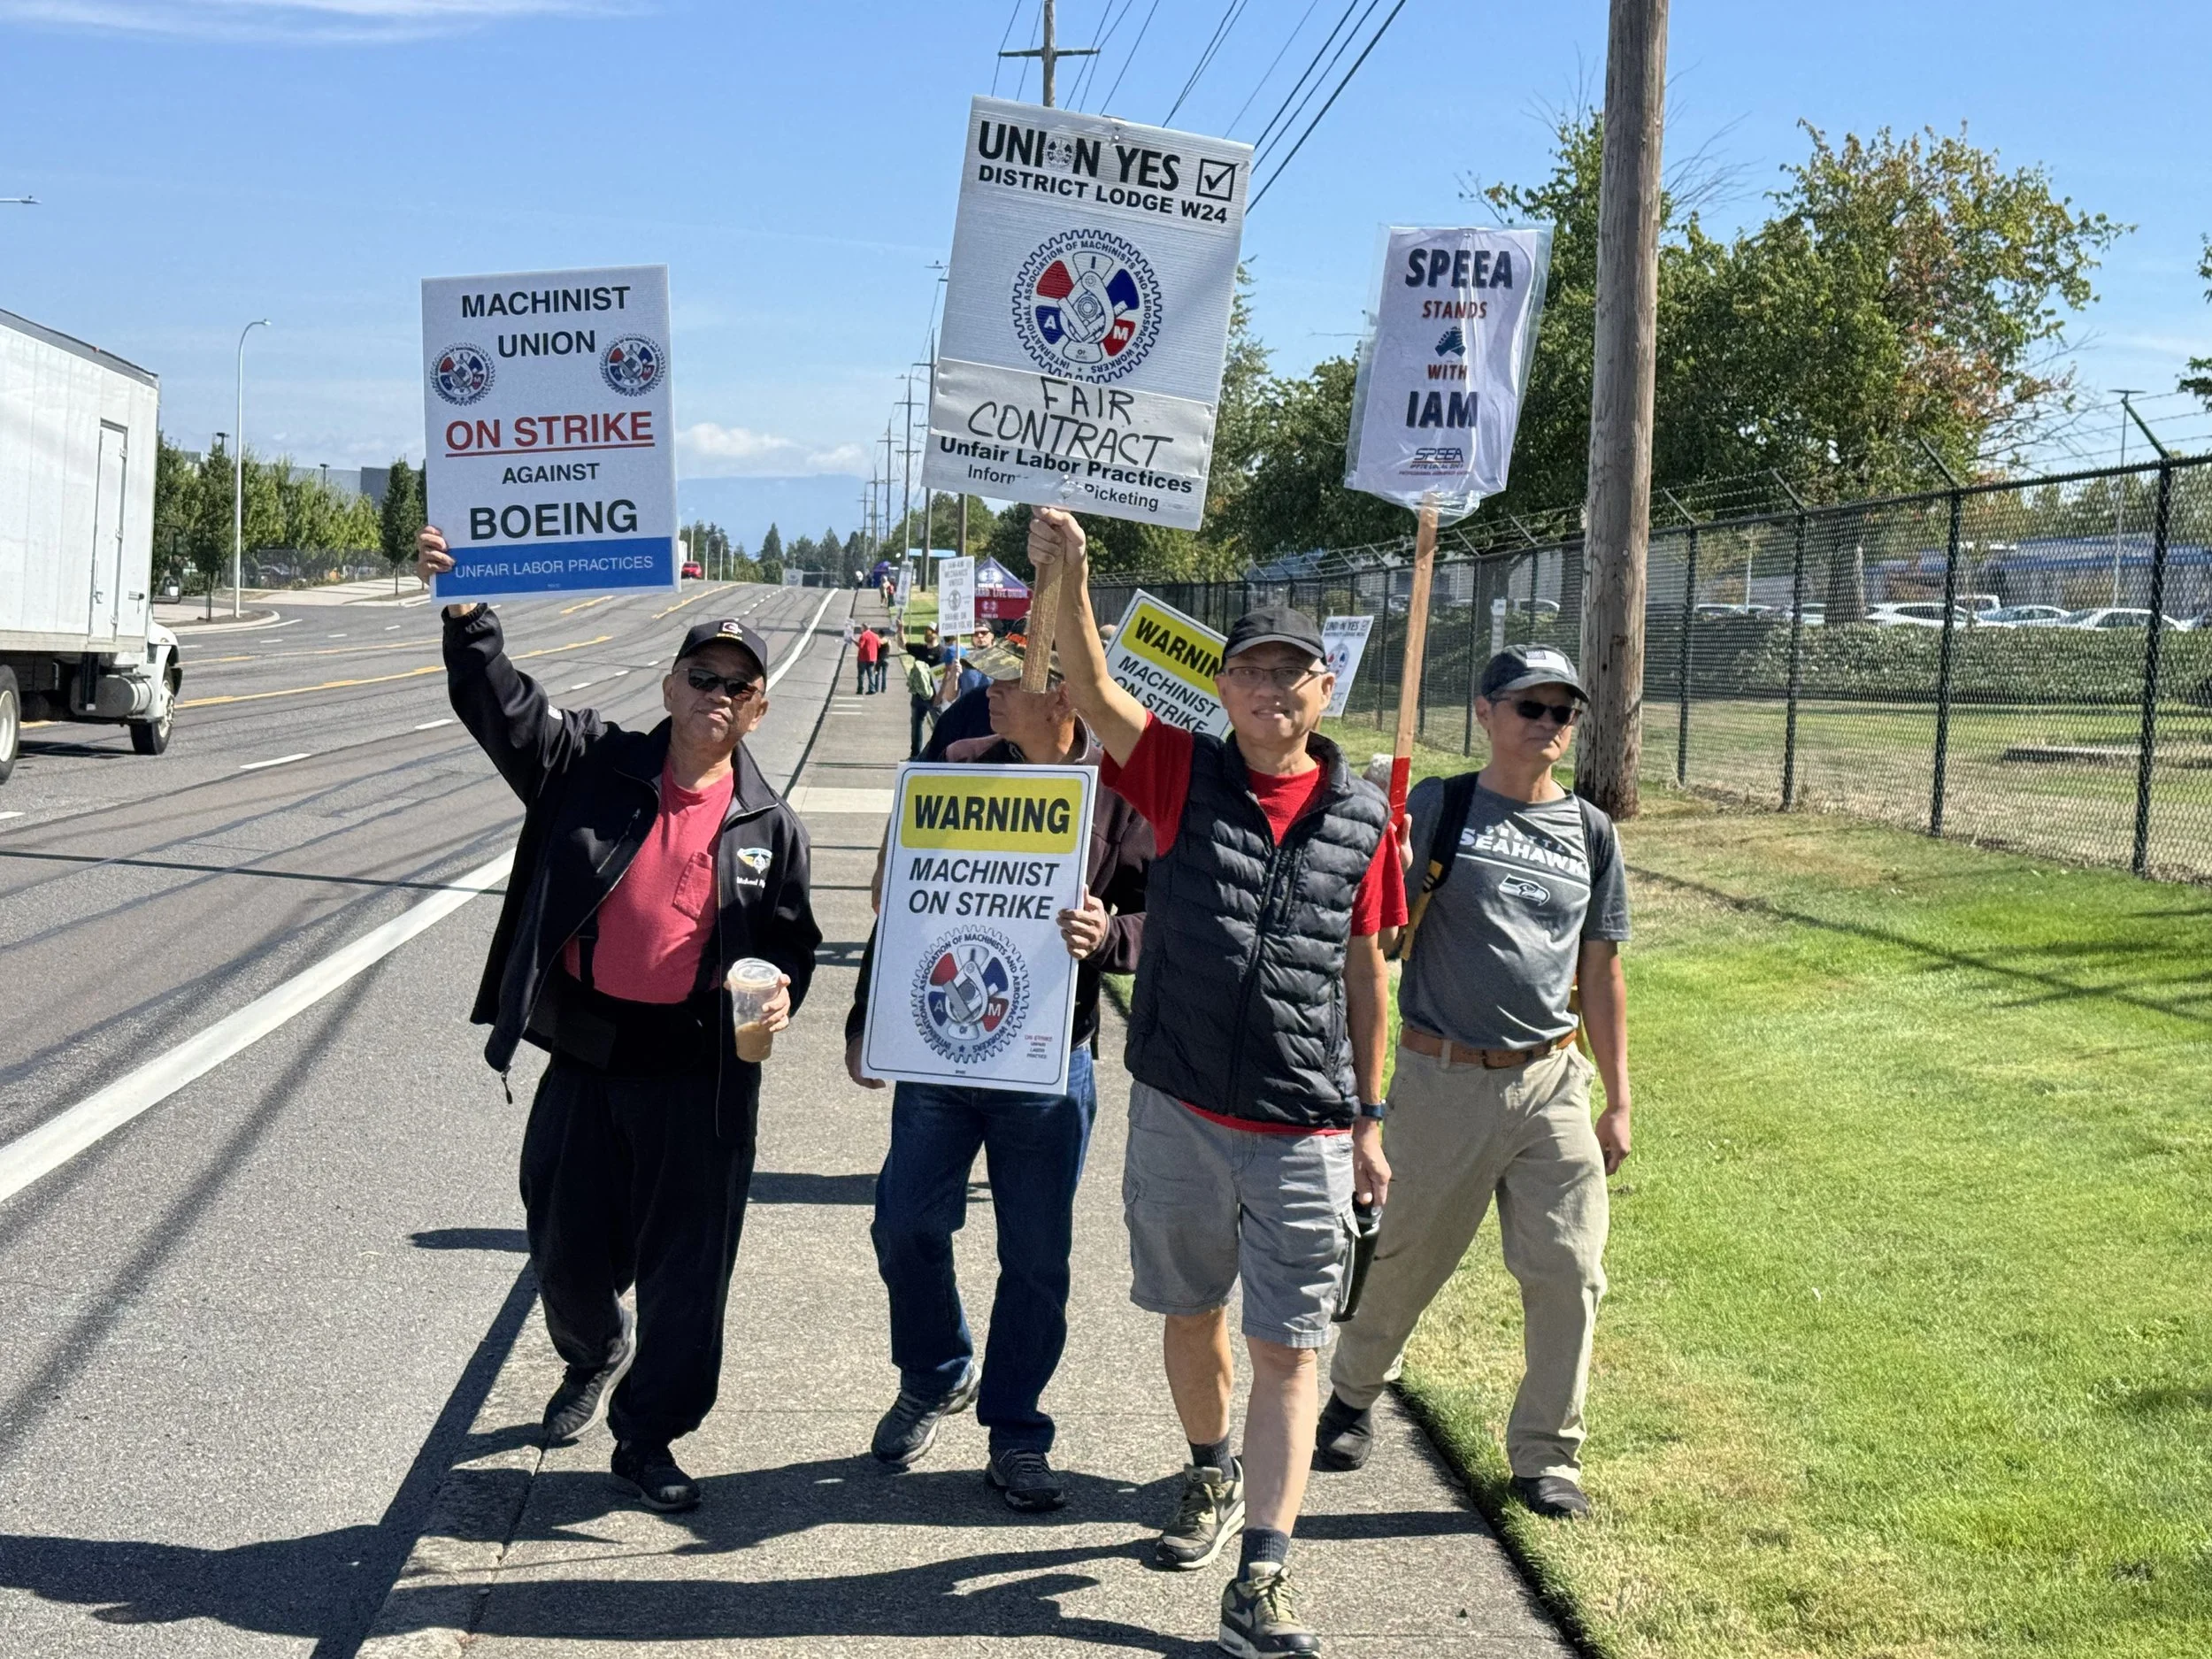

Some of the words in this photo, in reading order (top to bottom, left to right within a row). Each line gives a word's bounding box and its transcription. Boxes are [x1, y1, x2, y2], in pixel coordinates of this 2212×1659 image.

[1116, 145, 1180, 191] YES
[979, 165, 1088, 198] DISTRICT
[1095, 185, 1173, 214] LODGE
[1181, 199, 1227, 224] W24
[1065, 240, 1078, 250] OF
[1080, 240, 1137, 270] MACHINISTS
[1023, 247, 1064, 302] ASSOCIATION
[1133, 270, 1148, 295] AND
[1405, 248, 1513, 289] SPEEA
[462, 286, 631, 318] MACHINIST
[1422, 300, 1487, 319] STANDS
[1044, 315, 1057, 330] A
[1113, 326, 1129, 341] M
[1133, 292, 1153, 349] AEROSPACE
[498, 330, 595, 358] UNION
[1023, 304, 1071, 370] INTERNATIONAL
[1091, 348, 1135, 373] WORKERS
[1427, 364, 1468, 380] WITH
[1041, 376, 1134, 426] FAIR
[1406, 390, 1478, 428] IAM
[446, 419, 501, 450] ON
[515, 411, 654, 447] STRIKE
[968, 401, 1173, 467] CONTRACT
[940, 436, 1010, 463] Unfair
[1017, 445, 1080, 475] Labor
[1087, 461, 1193, 494] Practices
[1414, 448, 1463, 463] SPEEA
[502, 463, 600, 484] AGAINST
[470, 499, 637, 541] BOEING
[456, 562, 509, 579] UNFAIR
[513, 559, 564, 575] LABOR
[569, 556, 654, 572] PRACTICES
[1135, 616, 1221, 681] WARNIN
[1118, 656, 1220, 718] MACHINIST
[1113, 676, 1142, 698] ON
[1142, 693, 1209, 733] STRIKE
[915, 795, 1070, 834] WARNING
[1459, 827, 1590, 876] SEAHAWK
[909, 857, 1060, 887] MACHINIST
[909, 889, 949, 915] ON
[956, 893, 1054, 920] STRIKE
[952, 934, 964, 945] OF
[964, 933, 1008, 956] MACHINISTS
[919, 941, 952, 991] ASSOCIATION
[1005, 956, 1017, 973] AND
[934, 1000, 944, 1012] A
[988, 1004, 1001, 1017] M
[1005, 976, 1020, 1027] AEROSPACE
[918, 995, 952, 1050] INTERNATIONAL
[972, 1025, 1008, 1053] WORKERS
